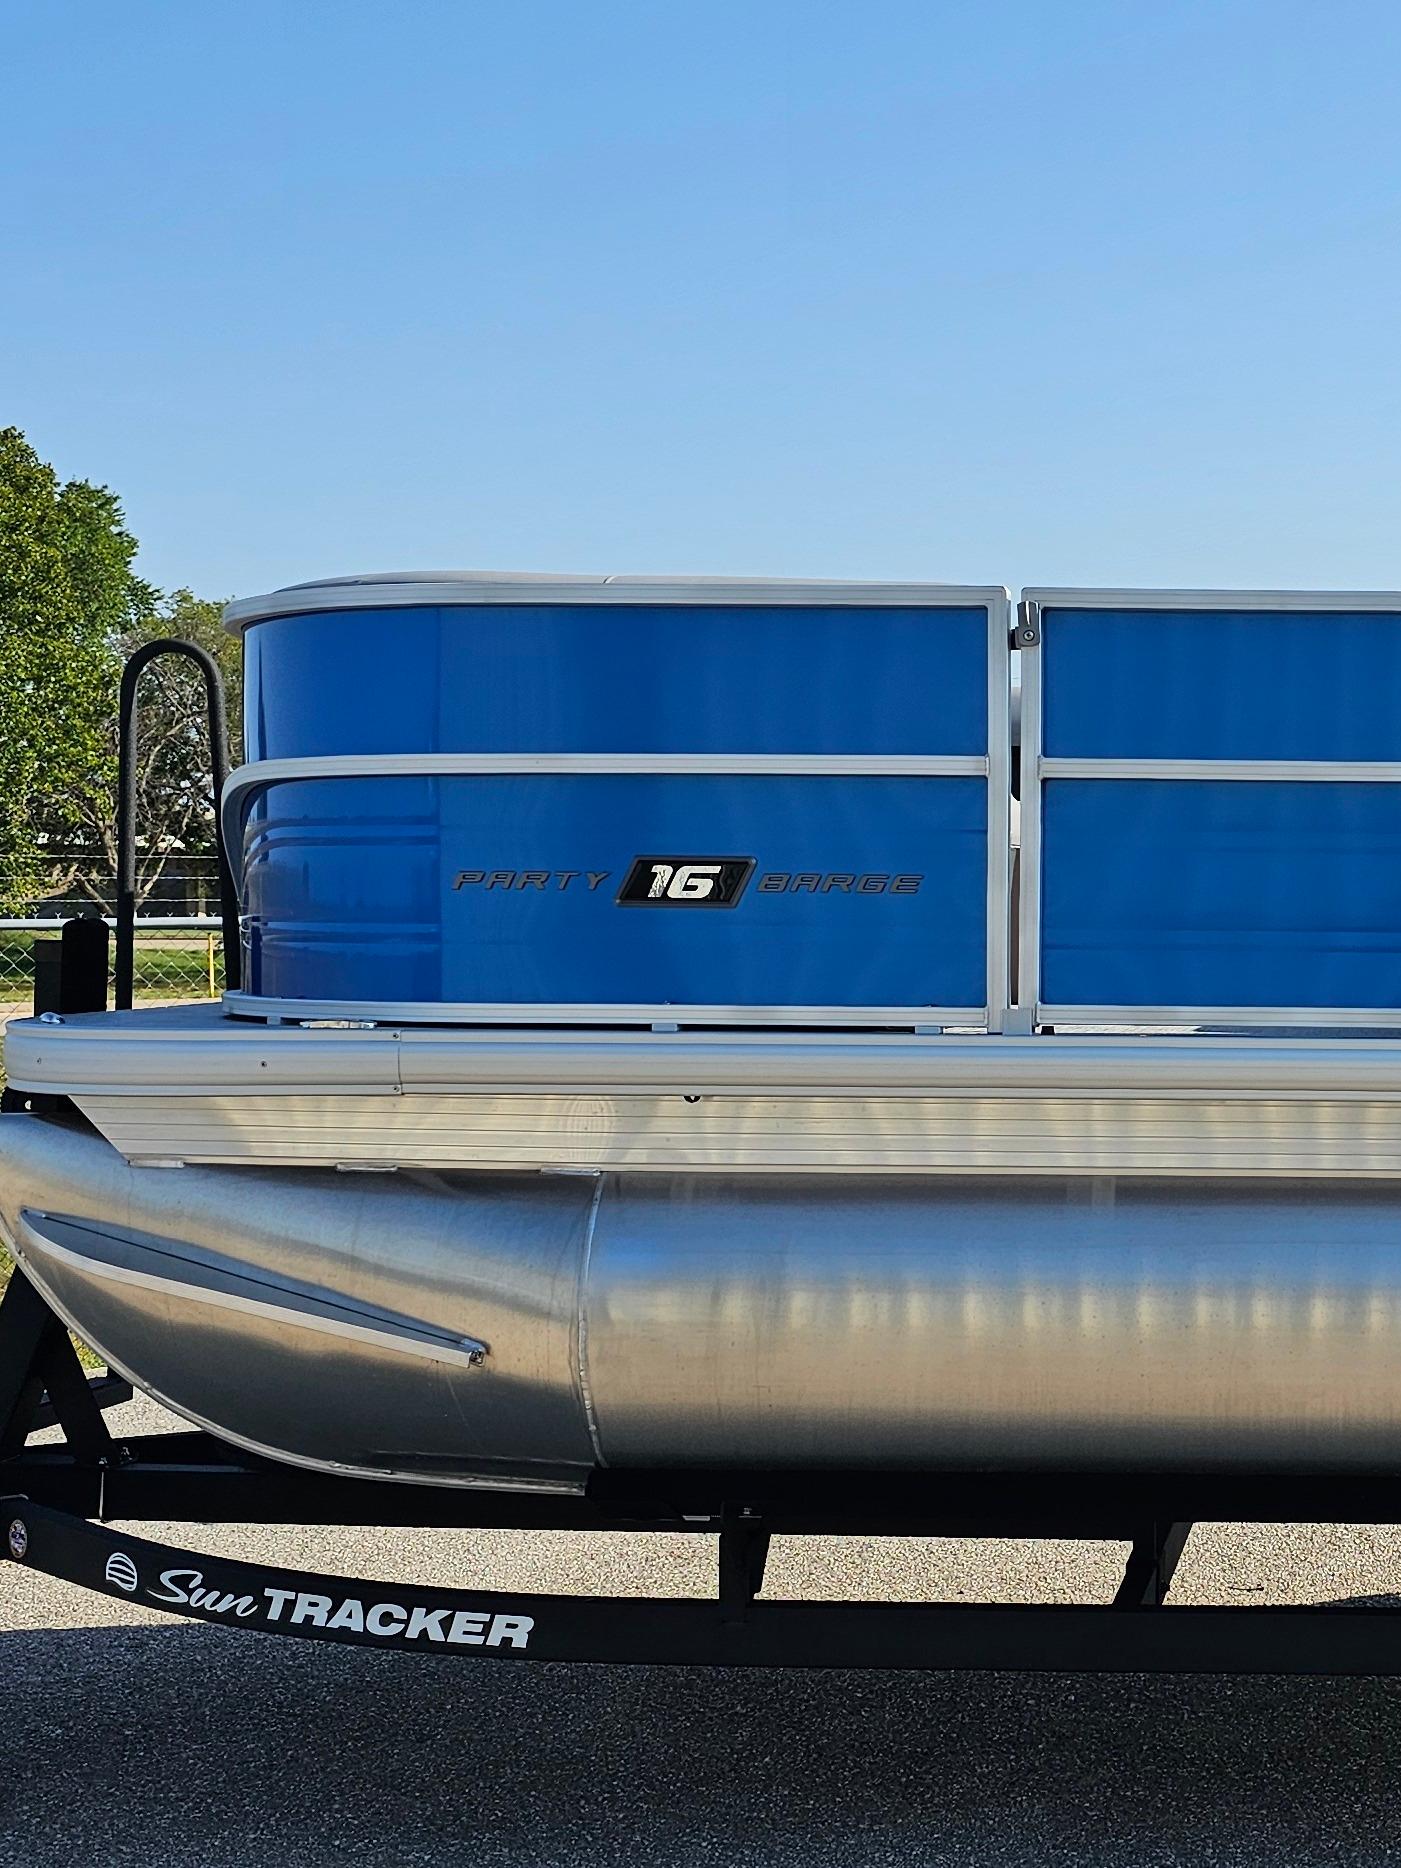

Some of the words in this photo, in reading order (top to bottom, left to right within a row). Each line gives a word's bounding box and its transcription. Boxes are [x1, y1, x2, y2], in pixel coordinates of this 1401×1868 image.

[452, 870, 612, 891] PARTY
[647, 864, 722, 899] 16
[757, 873, 925, 894] BARGE
[147, 1569, 260, 1617] Sun
[263, 1587, 535, 1649] TRACKER
